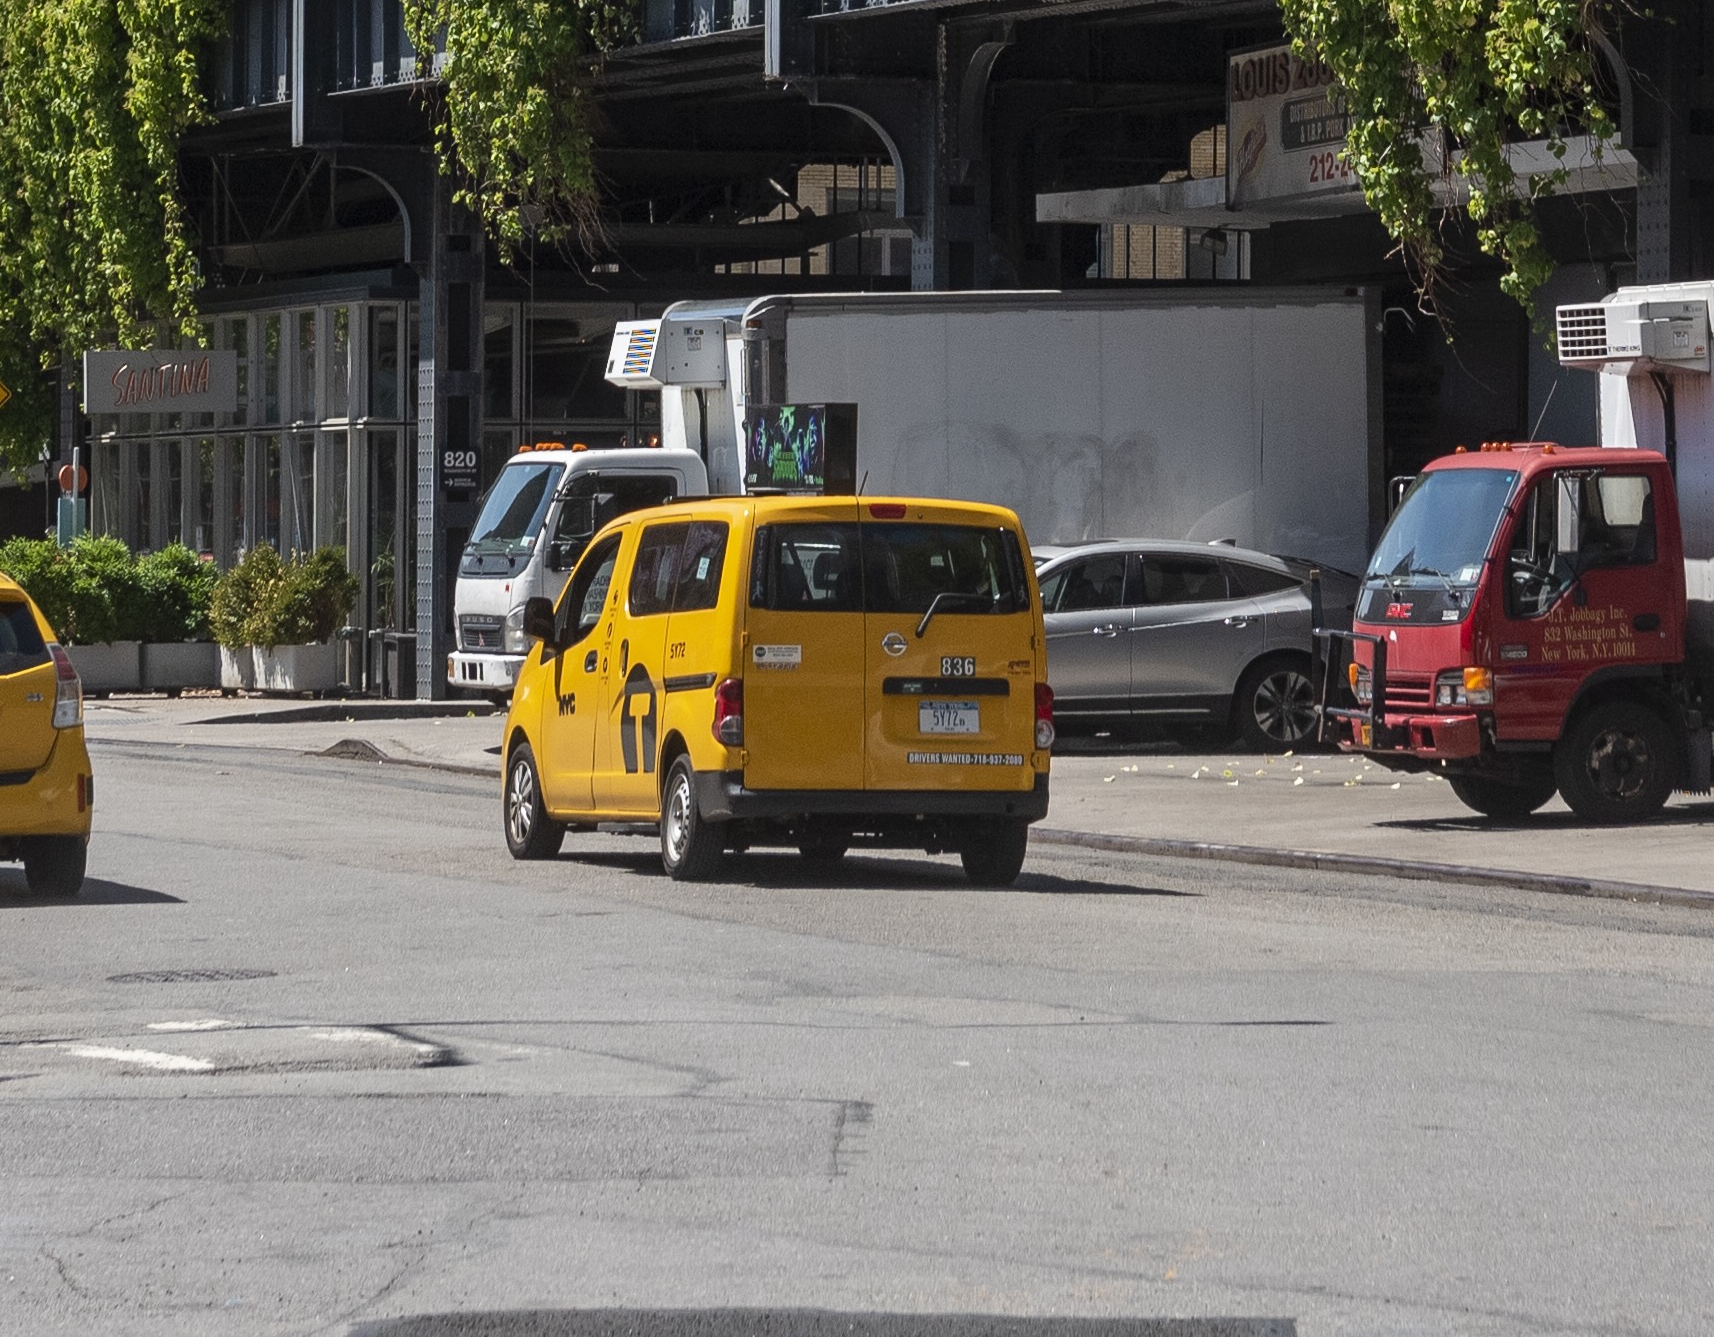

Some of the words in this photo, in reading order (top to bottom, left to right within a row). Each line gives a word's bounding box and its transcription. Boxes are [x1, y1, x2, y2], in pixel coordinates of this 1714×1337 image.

[1230, 51, 1290, 103] LOUIS
[111, 356, 210, 408] SANTINA
[443, 451, 477, 467] 820
[1570, 606, 1607, 624] Jobbagy
[1609, 604, 1628, 619] Inc.
[1544, 626, 1561, 643] 832
[1564, 625, 1616, 643] Washington
[1619, 623, 1633, 639] St.
[670, 642, 686, 659] 5Y72
[1541, 646, 1561, 662] New
[1566, 645, 1589, 662] York,
[1592, 643, 1611, 659] N.Y.
[1613, 642, 1636, 657] 10014
[941, 657, 974, 675] 836
[558, 692, 576, 717] NYC
[909, 752, 940, 764] DRIVERS
